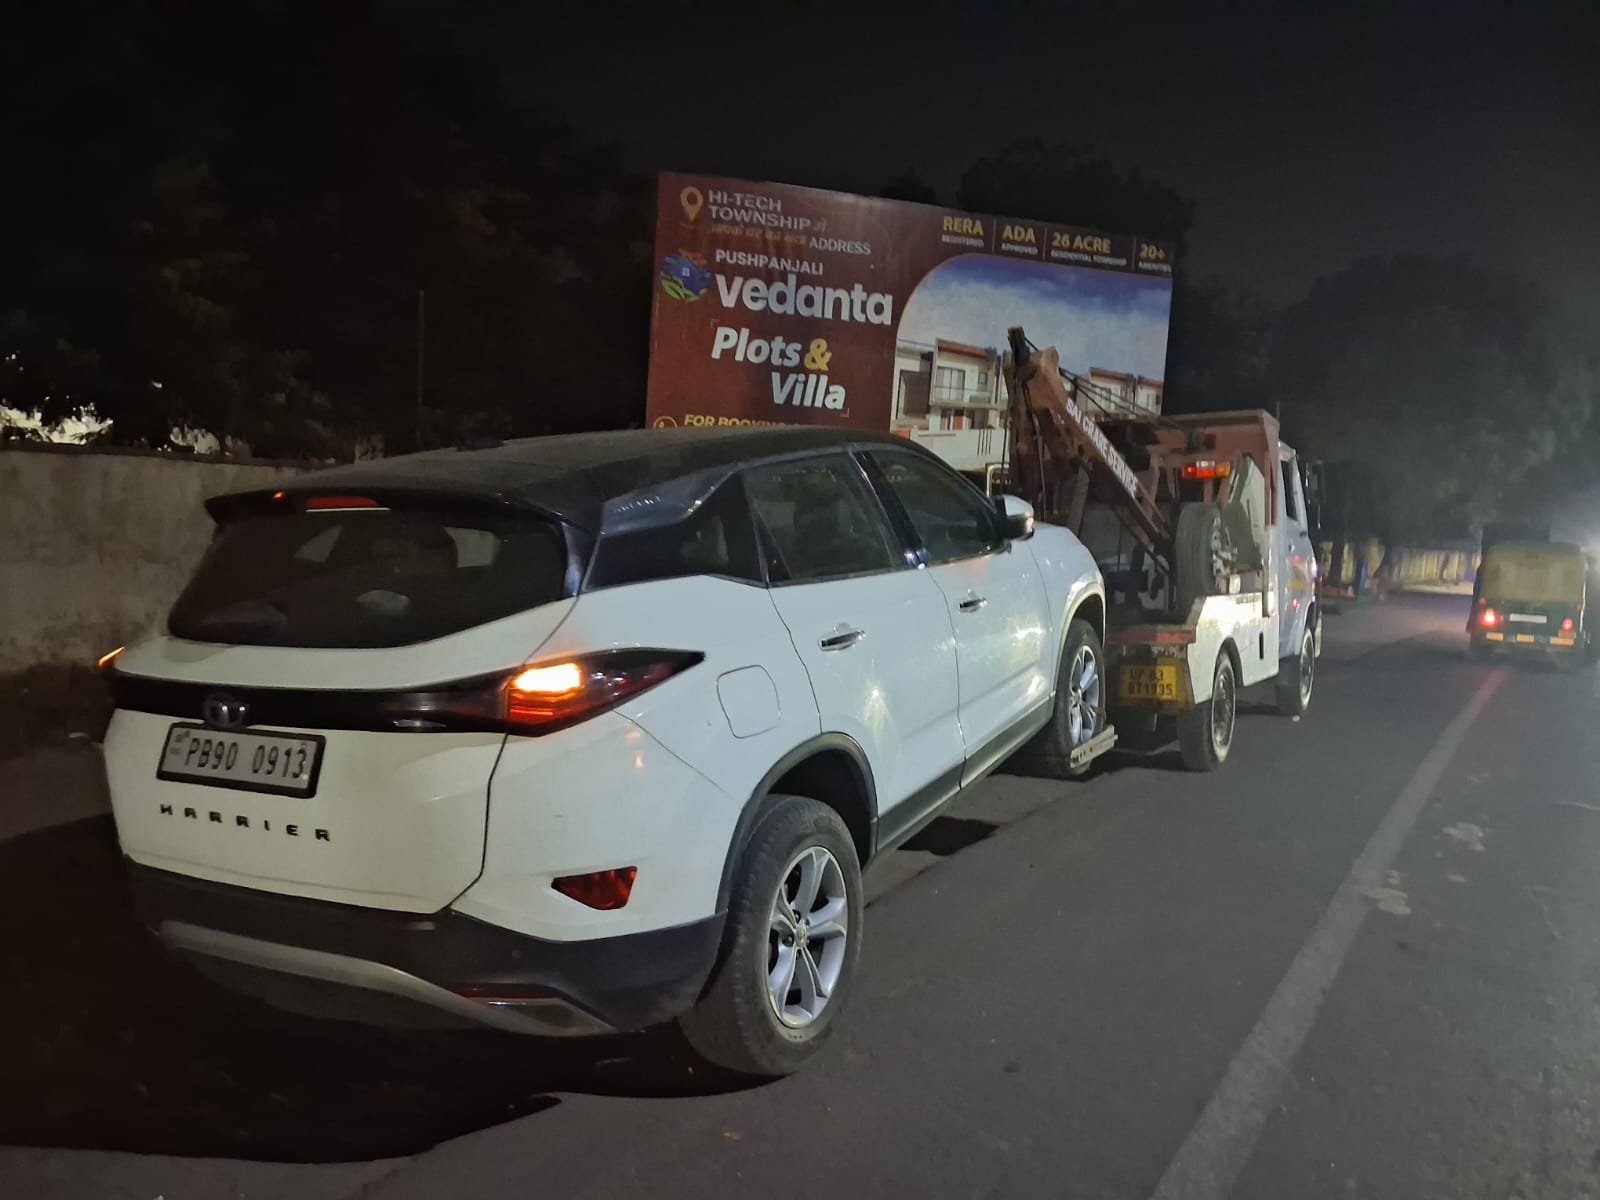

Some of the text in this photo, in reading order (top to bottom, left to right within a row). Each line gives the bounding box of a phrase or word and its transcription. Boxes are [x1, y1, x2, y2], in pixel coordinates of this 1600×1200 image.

[708, 190, 782, 212] HI-TECH
[708, 205, 812, 231] TOWNSHIP
[943, 216, 984, 237] RERA
[809, 237, 872, 256] ADDRESS
[1002, 224, 1036, 243] ADA
[1051, 232, 1111, 255] 26 ACRE
[715, 249, 824, 276] PUSHPANJALI
[711, 327, 833, 371] Plots &
[771, 372, 847, 410] Villa
[684, 413, 785, 428] FOR BOOK
[1082, 415, 1108, 458] CRANE
[1107, 446, 1138, 496] SERVICE
[184, 738, 307, 779] PB90 0913
[160, 803, 331, 842] HARRIER
